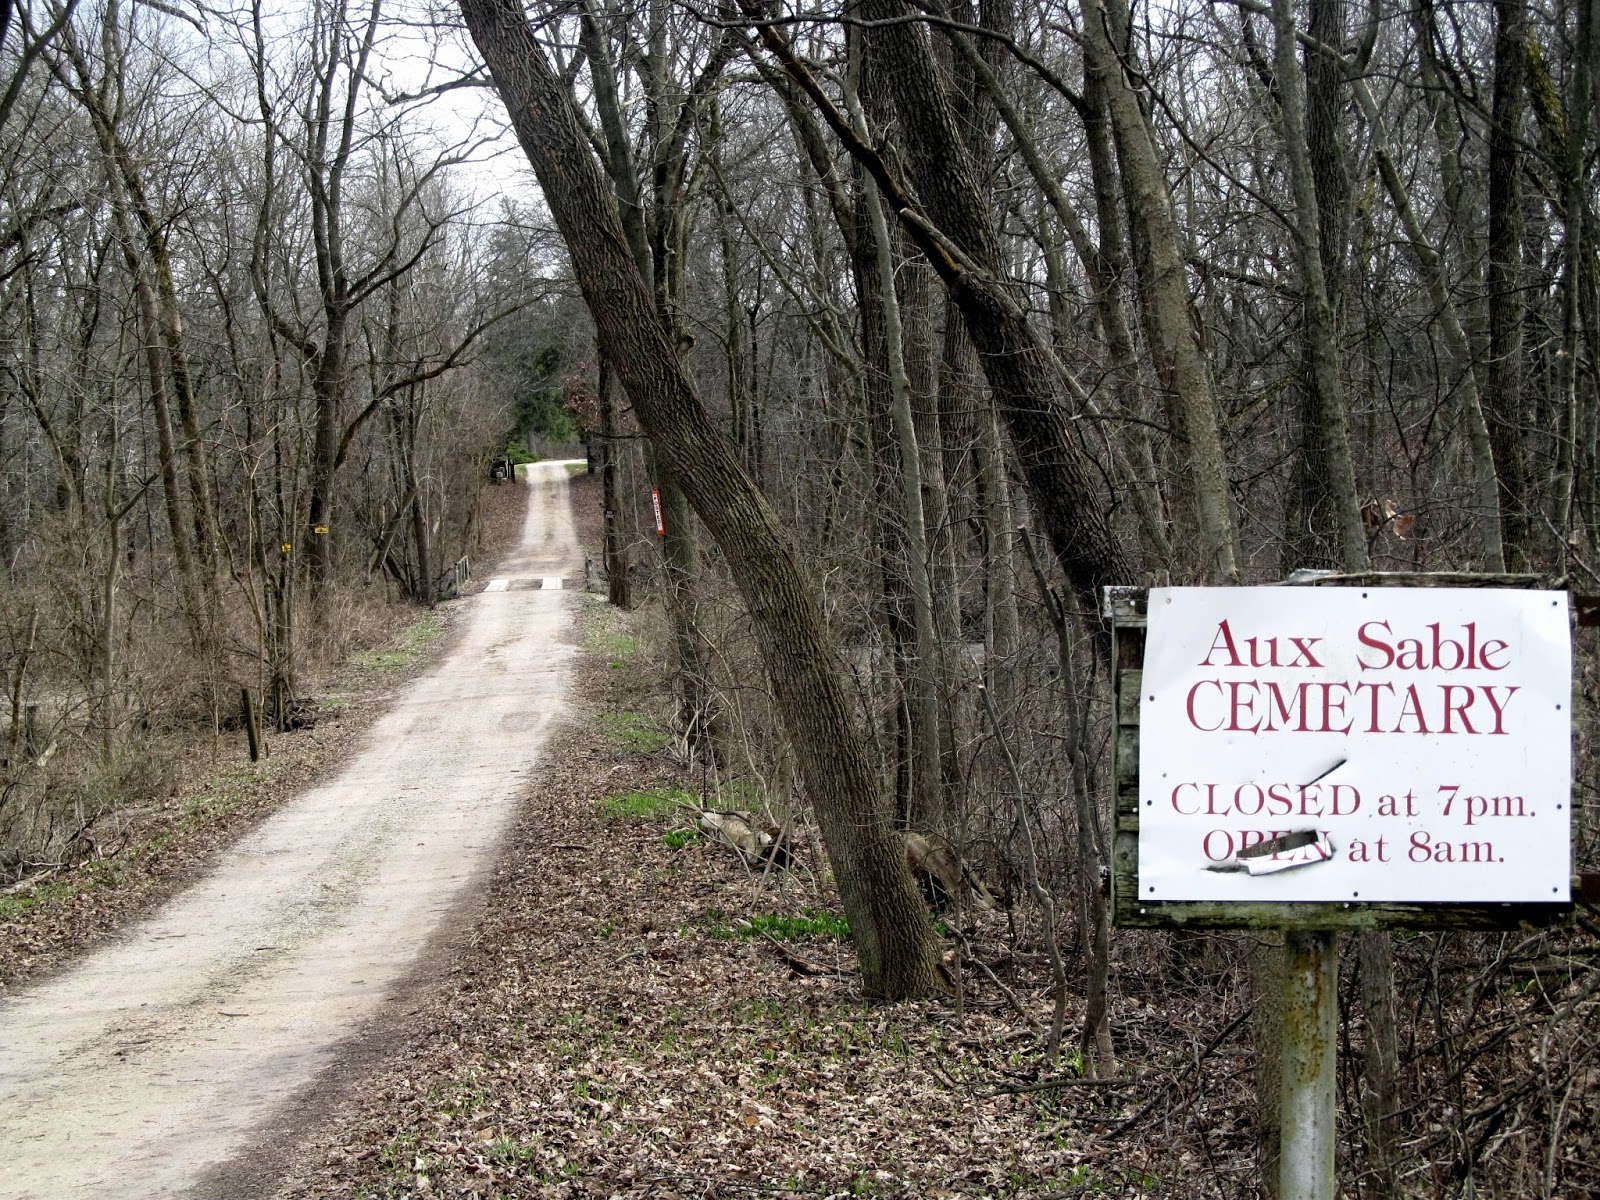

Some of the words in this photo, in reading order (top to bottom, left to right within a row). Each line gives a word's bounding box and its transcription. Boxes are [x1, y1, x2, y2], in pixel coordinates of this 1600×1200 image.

[1198, 619, 1324, 668] Aux
[1356, 620, 1510, 671] Sable
[1186, 679, 1521, 736] CEMETARY
[1171, 782, 1361, 818] CLOSED
[1378, 787, 1419, 817] at
[1438, 785, 1537, 826] 7pm.
[1349, 833, 1391, 863] at
[1408, 831, 1505, 863] 8am.
